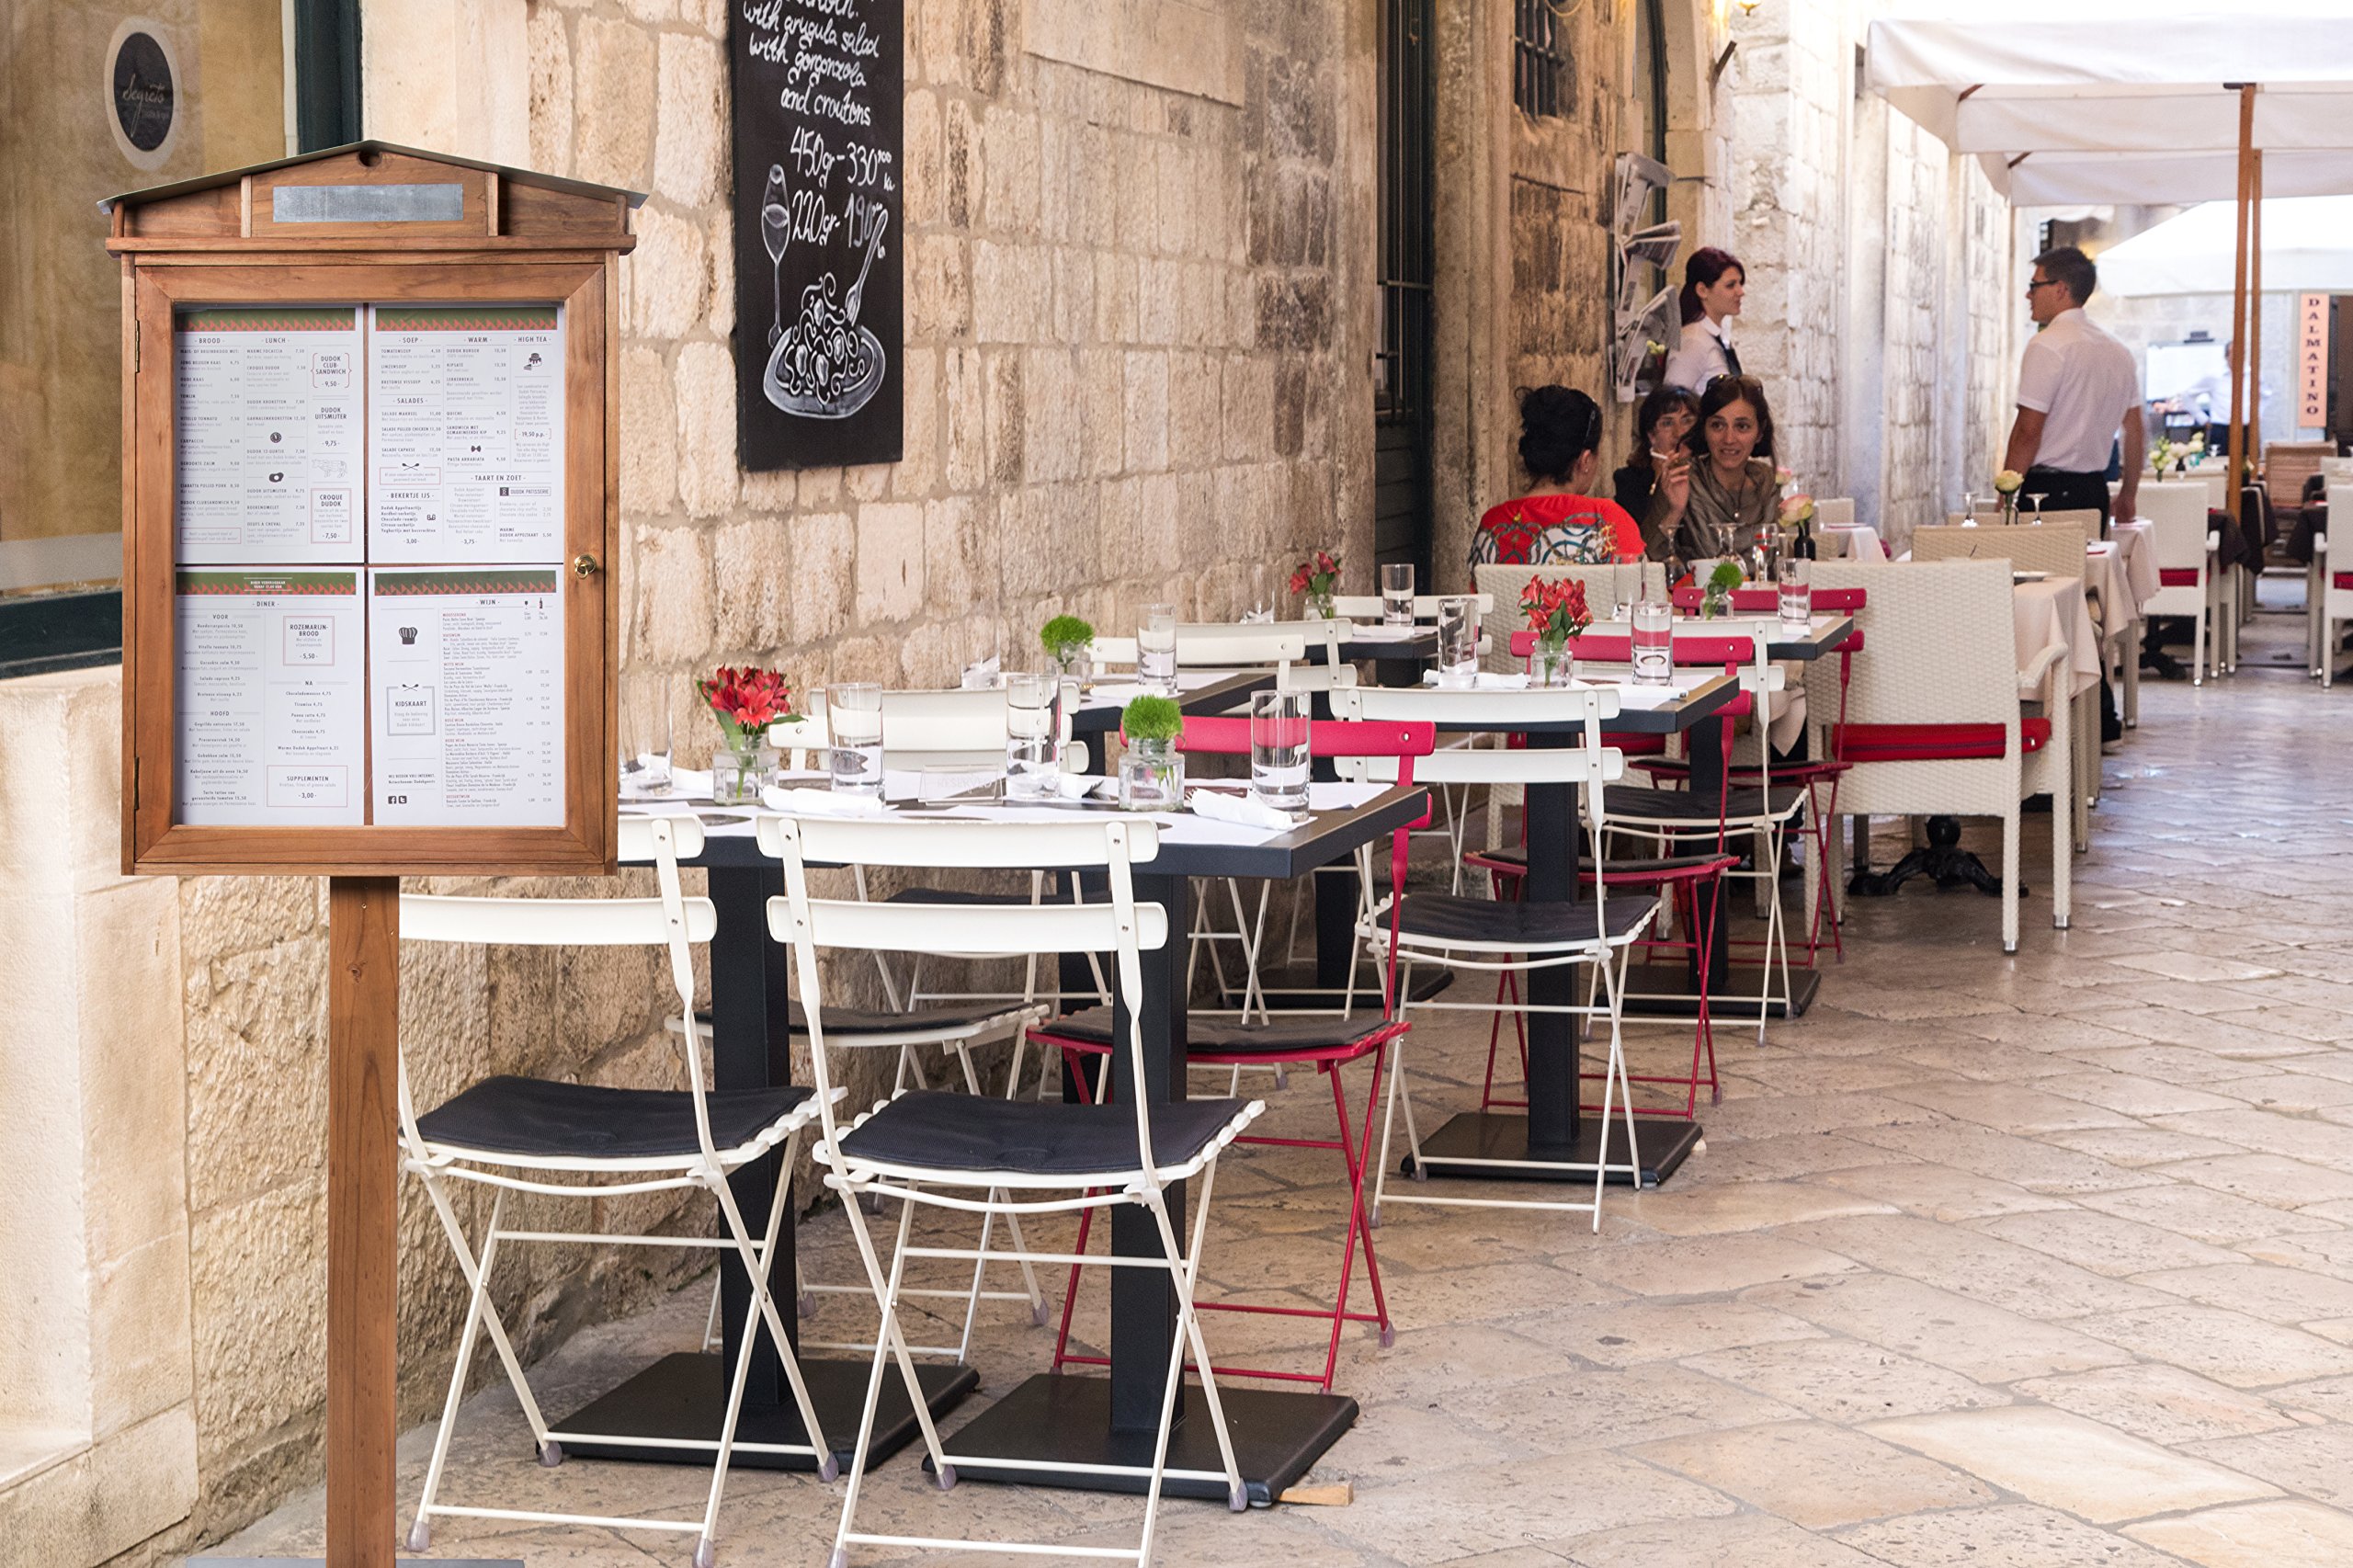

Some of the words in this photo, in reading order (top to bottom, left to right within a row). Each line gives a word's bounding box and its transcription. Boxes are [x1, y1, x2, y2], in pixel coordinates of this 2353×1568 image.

[749, 32, 789, 64] with
[787, 50, 867, 87] gorgonzola
[841, 22, 880, 56] salad
[780, 86, 810, 115] and
[813, 90, 871, 127] croutons
[2306, 298, 2321, 415] DALMATINO
